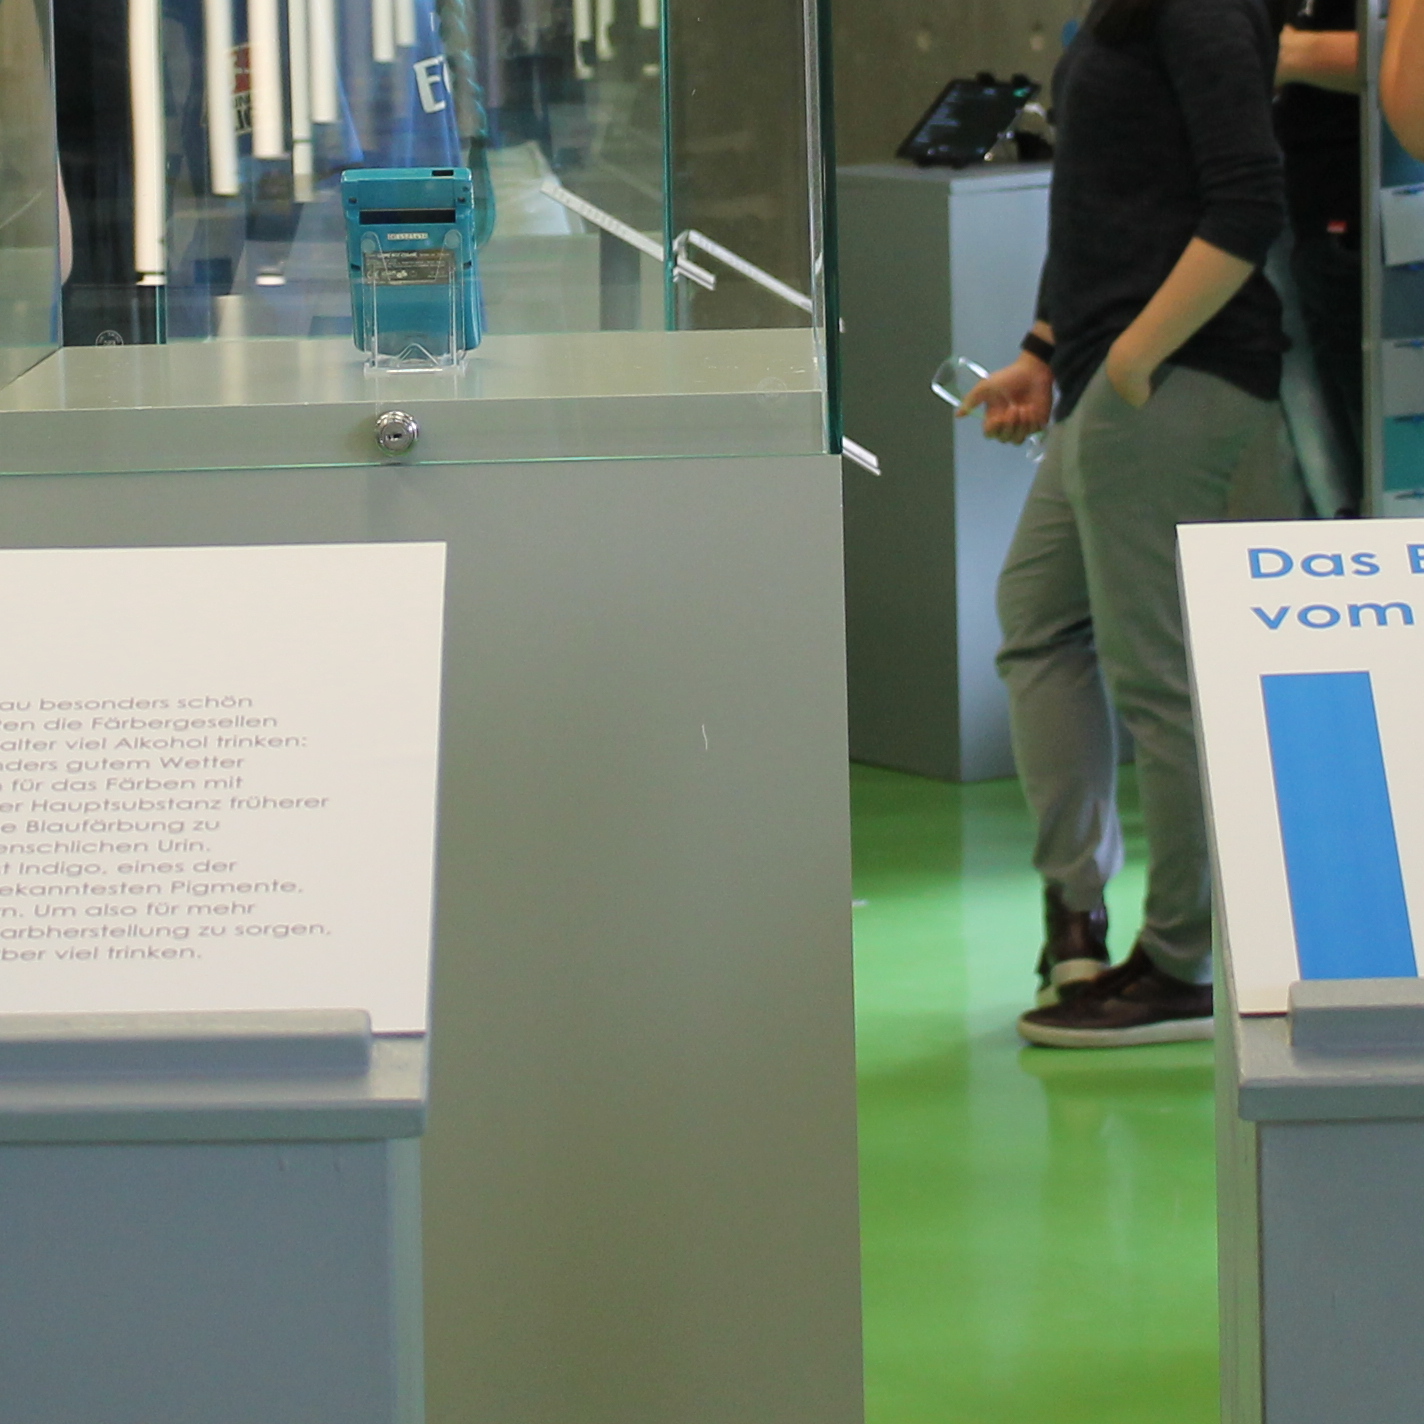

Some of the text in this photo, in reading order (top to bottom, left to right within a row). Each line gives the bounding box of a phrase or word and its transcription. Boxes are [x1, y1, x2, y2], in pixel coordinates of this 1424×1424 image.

[413, 53, 452, 114] E
[1248, 548, 1380, 579] Das
[1253, 602, 1415, 630] vom
[38, 696, 170, 712] besonders
[177, 694, 253, 710] schön
[43, 717, 83, 731] die
[91, 714, 278, 733] Färbergesellen
[64, 736, 108, 751] viel
[113, 734, 209, 751] Alkohol
[216, 734, 307, 749] trinken:
[65, 756, 151, 775] gutem
[159, 755, 245, 770] Wetter
[11, 778, 44, 793] für
[50, 777, 98, 793] das
[105, 776, 196, 792] Färben
[203, 775, 243, 790] mit
[30, 797, 222, 815] Hauptsubstanz
[229, 795, 329, 810] früherer
[25, 818, 186, 835] Blaufärbung
[192, 820, 221, 832] zu
[157, 838, 211, 853] Urin.
[116, 859, 185, 875] eines
[192, 858, 237, 874] der
[33, 903, 77, 919] Um
[84, 902, 138, 918] also
[146, 901, 180, 917] für
[186, 900, 256, 916] mehr
[197, 925, 227, 938] zu
[54, 945, 99, 961] viel
[107, 944, 202, 960] trinken.
